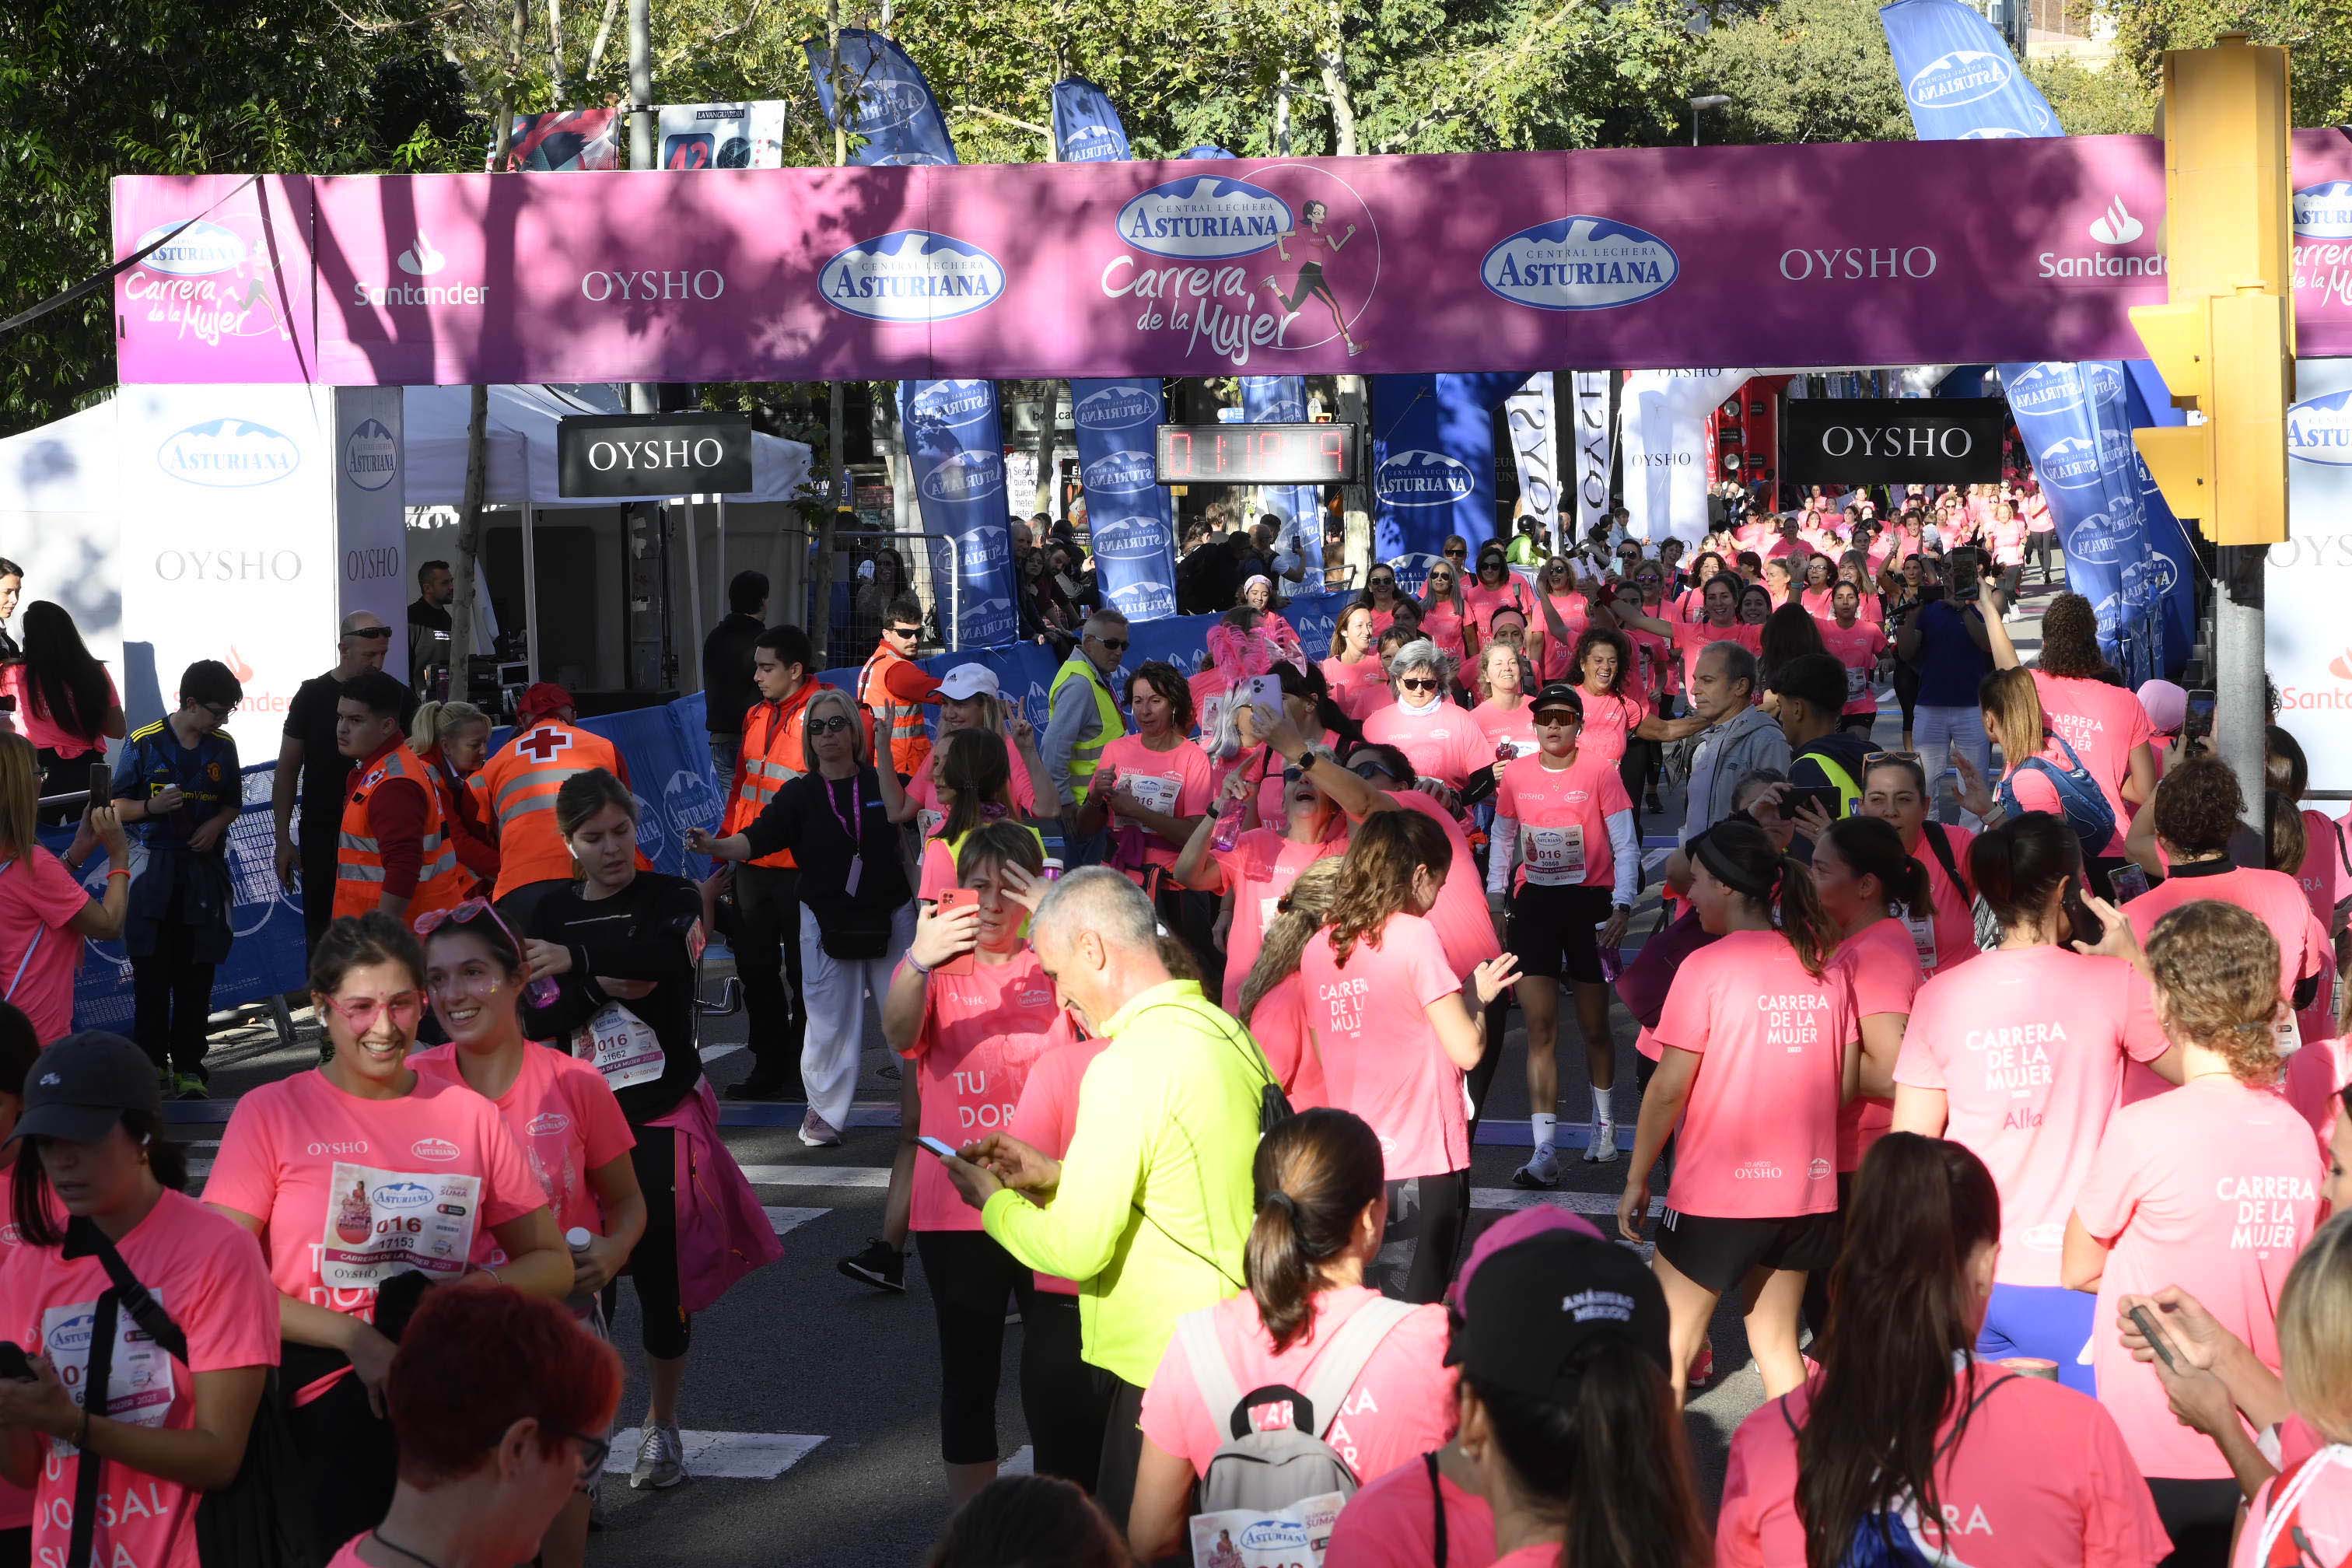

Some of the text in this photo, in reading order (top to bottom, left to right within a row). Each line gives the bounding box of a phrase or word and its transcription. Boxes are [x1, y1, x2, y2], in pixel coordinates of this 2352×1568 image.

[1157, 202, 1275, 214] CENTRAL LECHERA
[1130, 207, 1283, 239] ASTURIANA
[1526, 247, 1657, 259] CENTRAL LECHERA
[1779, 246, 1937, 281] OYSHO
[862, 261, 985, 271] CENTRAL LECHERA
[1101, 255, 1248, 299] Carrera
[1496, 253, 1664, 288] ASTURIANA
[124, 271, 216, 300] Carrera
[354, 280, 489, 306] Santander
[581, 269, 724, 303] OYSHO
[833, 264, 991, 299] ASTURIANA
[149, 298, 252, 347] de la Mujer
[1136, 292, 1301, 366] de la Mujer
[1822, 425, 1973, 458] OYSHO
[168, 444, 290, 470] ASTURIANA
[349, 446, 394, 473] ASTURIANA
[588, 438, 723, 471] OYSHO
[1632, 452, 1692, 467] OYSHO
[1379, 473, 1467, 494] ASTURIANA
[155, 550, 303, 582] OYSHO
[347, 546, 399, 582] OYSHO
[2075, 727, 2091, 740] LA
[1538, 850, 1562, 859] 016
[1331, 1000, 1348, 1016] DE
[1757, 994, 1830, 1012] CARRERA
[1769, 1011, 1816, 1028] DE LA
[597, 1033, 628, 1052] 016
[1766, 1027, 1818, 1045] MUJER
[1965, 1020, 2067, 1052] CARRERA
[602, 1049, 627, 1063] 31662
[1988, 1045, 2049, 1070] DE LA
[952, 1070, 986, 1096] TU
[1985, 1063, 2054, 1090] MUJER
[307, 1140, 369, 1156] OYSHO
[415, 1145, 457, 1157] ASTURIANA
[1734, 1167, 1782, 1179] OYSHO
[376, 1191, 429, 1204] ASTURIANA
[2216, 1175, 2315, 1202] CARRERA
[376, 1215, 422, 1234] 016
[2238, 1201, 2294, 1225] DE LA
[379, 1237, 415, 1249] 17153
[2230, 1225, 2296, 1249] MUJER
[339, 1254, 380, 1262] CARRERA
[334, 1268, 380, 1279] OYSHO
